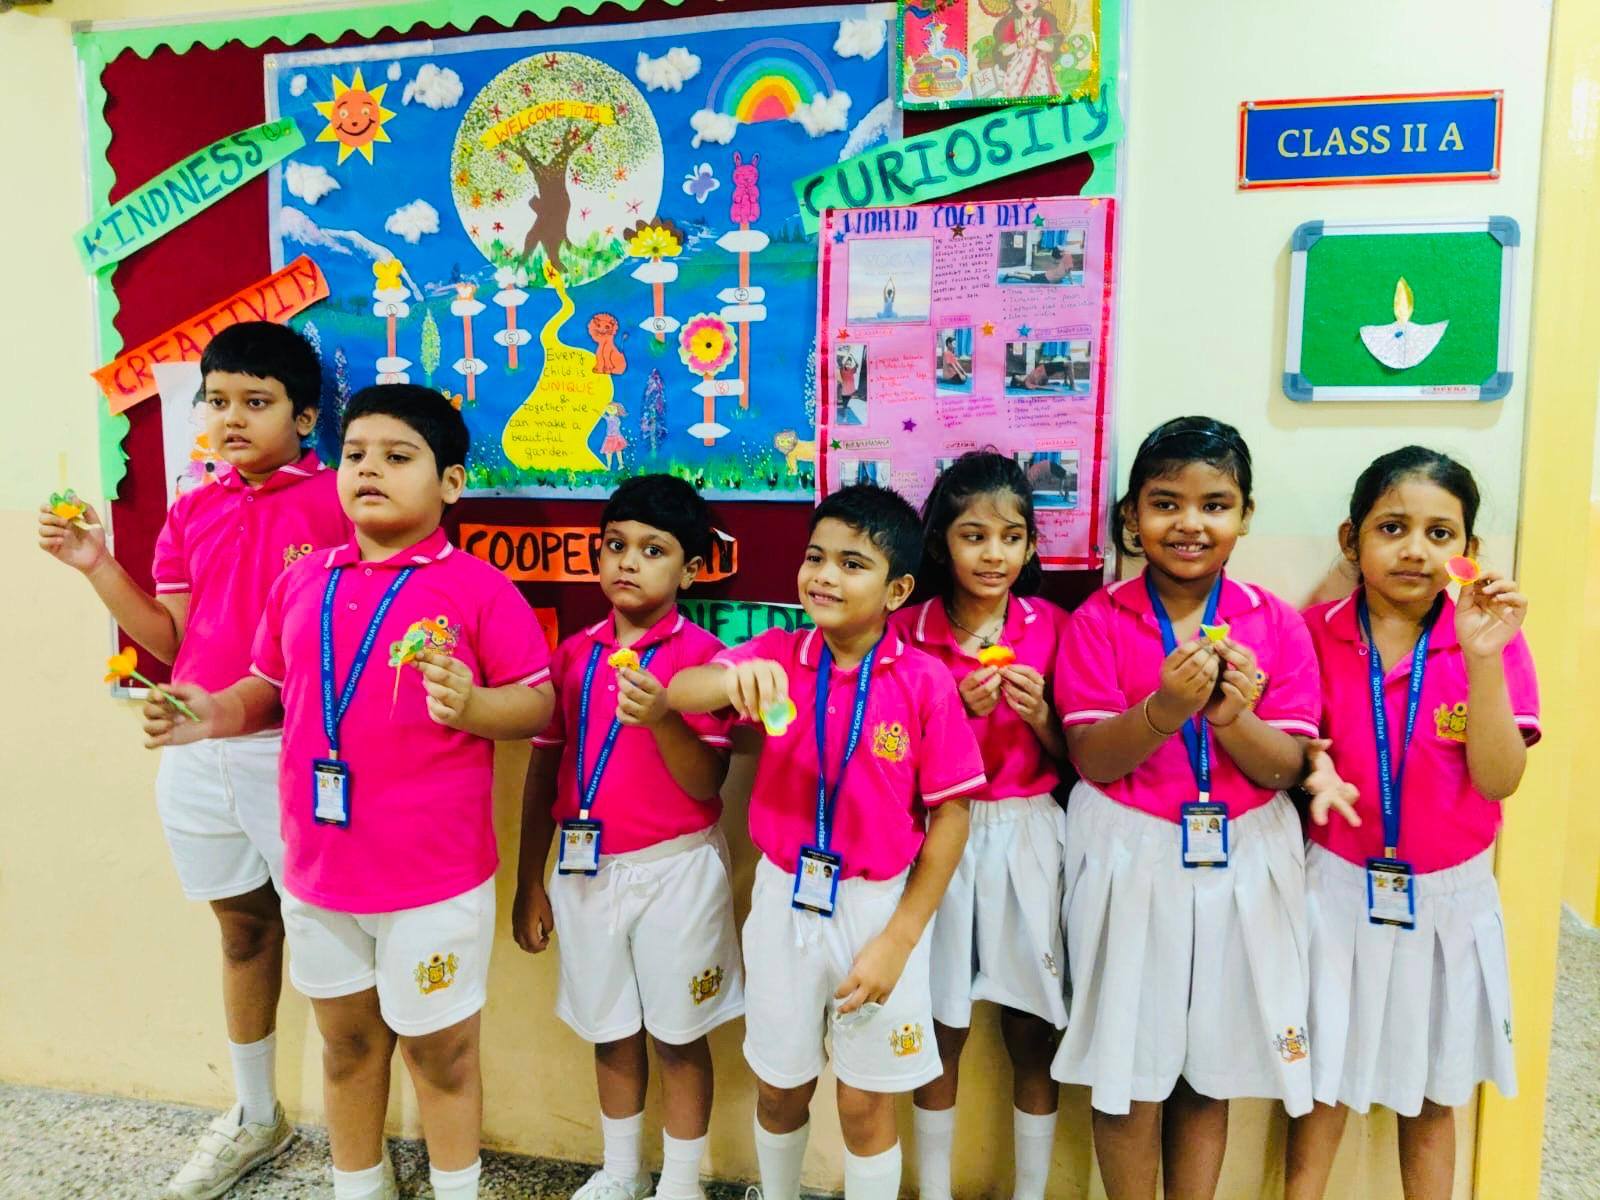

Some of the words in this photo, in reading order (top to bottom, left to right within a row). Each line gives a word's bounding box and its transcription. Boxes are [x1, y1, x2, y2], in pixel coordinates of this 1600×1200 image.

[493, 102, 566, 141] WELCOME
[803, 84, 1109, 217] CURIOSITY
[1277, 125, 1391, 158] CLASS
[1401, 123, 1429, 153] II
[1438, 122, 1465, 151] A
[83, 132, 264, 258] KINDNESS
[843, 208, 918, 235] WORLD
[932, 204, 985, 228] YOGA
[996, 202, 1036, 227] DAY
[113, 259, 319, 396] CREATIVITY
[546, 347, 585, 366] Every
[541, 381, 595, 396] UNIQUE
[576, 369, 586, 378] is
[511, 432, 564, 446] beautiful
[535, 420, 568, 430] make
[466, 530, 734, 575] COOPERN
[391, 568, 412, 592] APEEJAY
[361, 623, 377, 655] APEEJAY
[373, 597, 392, 625] SCHOOL
[323, 640, 332, 672] APEEJAY
[324, 680, 332, 706] SCHOOL
[335, 690, 351, 723] APEEJAY
[347, 661, 363, 691] SCHOOL
[585, 666, 594, 690] SCHOOL
[860, 662, 871, 693] APEEJAY
[1373, 676, 1382, 709] SCHOOL
[1412, 660, 1424, 693] APEEJAY
[853, 700, 864, 732] SCHOOL
[1374, 708, 1385, 740] APEEJAY
[1407, 701, 1417, 734] SCHOOL
[586, 774, 599, 803] APEEJAY
[596, 748, 609, 775] SCHOOL
[1200, 752, 1208, 781] APEEJAY
[1380, 750, 1388, 783] SCHOOL
[1383, 782, 1393, 815] APEEJAY
